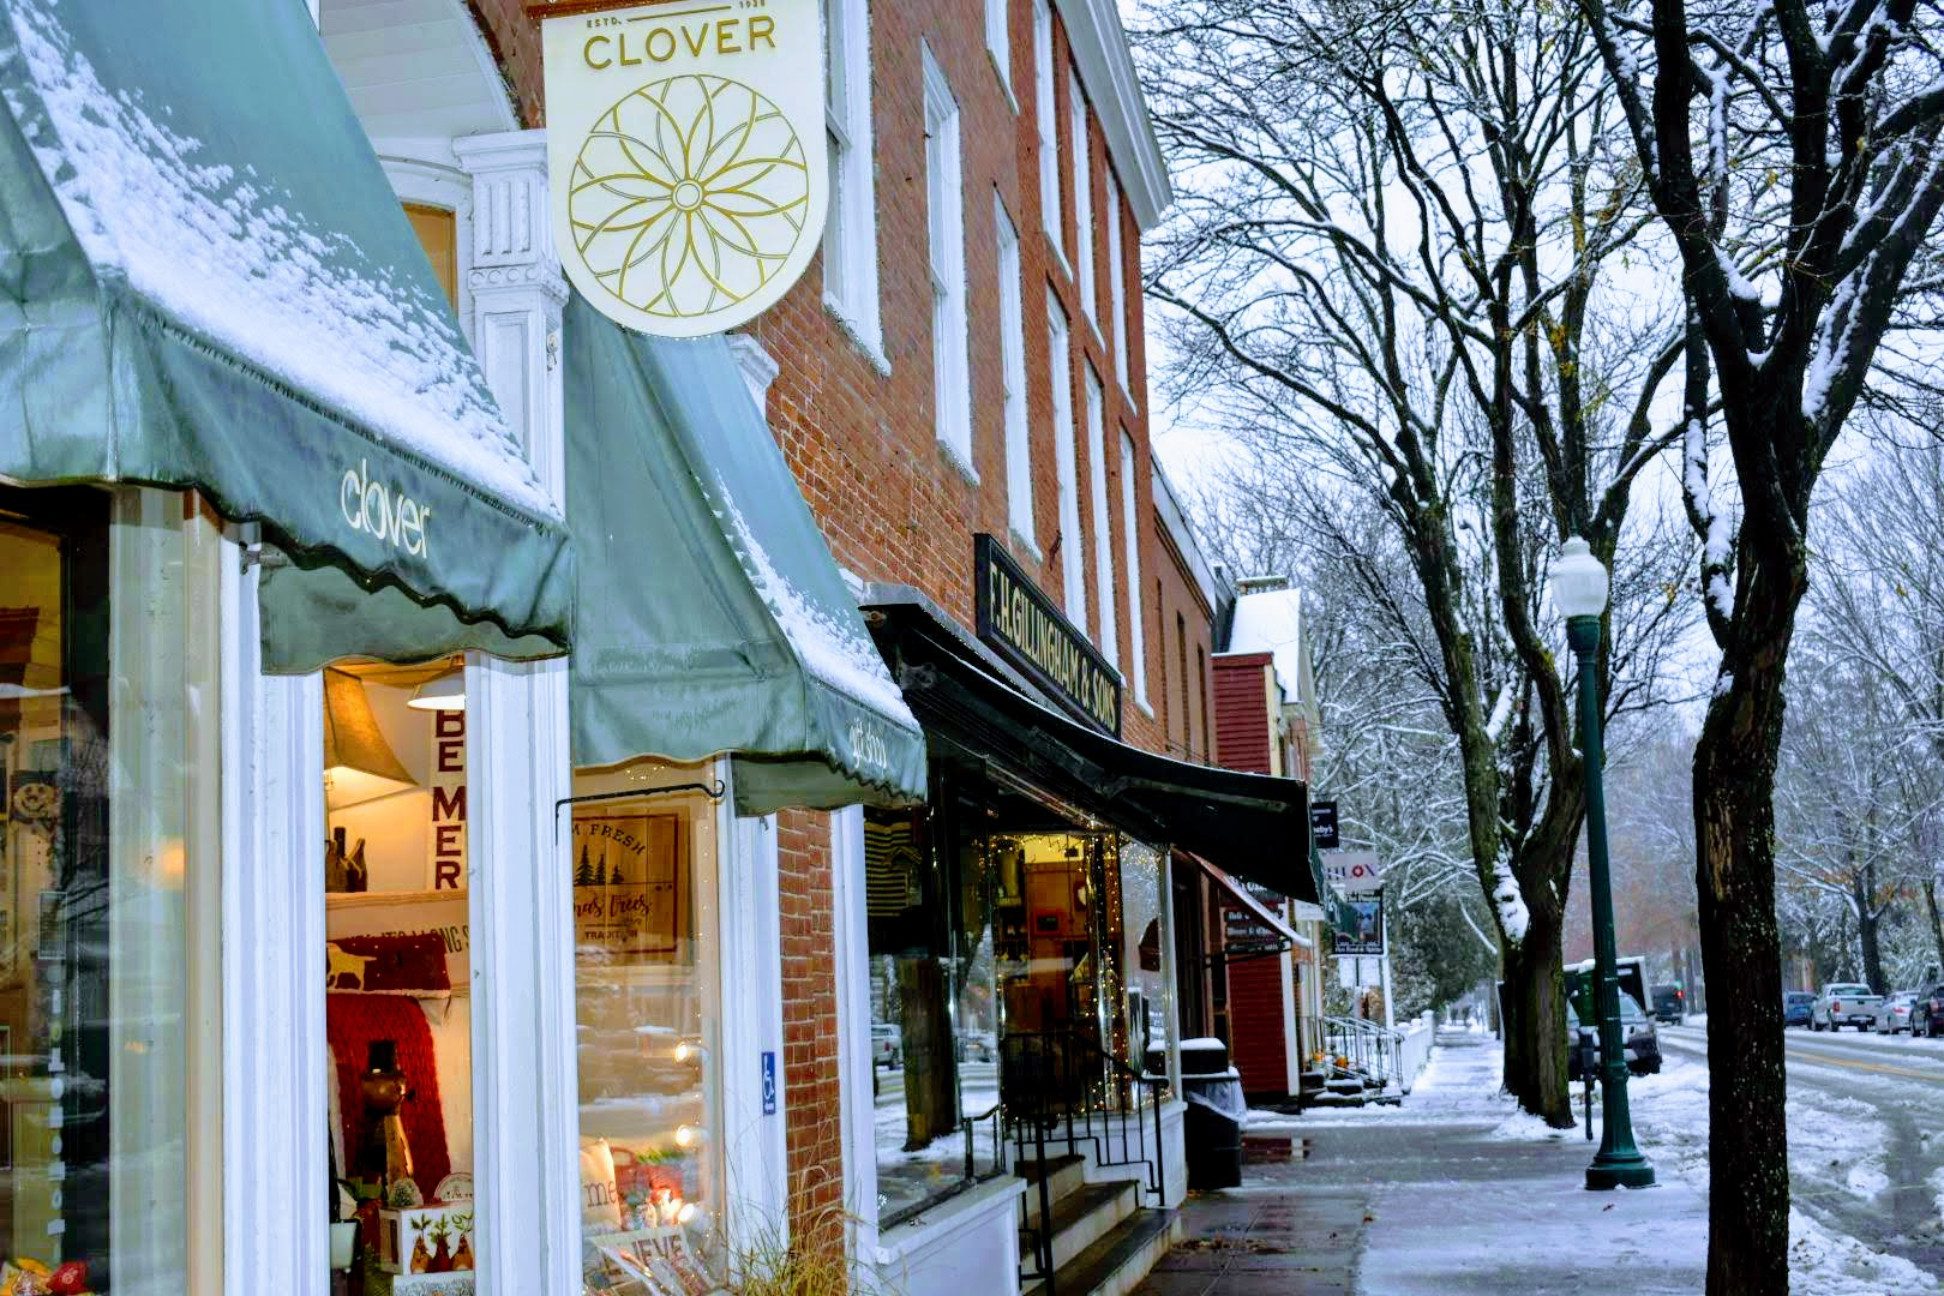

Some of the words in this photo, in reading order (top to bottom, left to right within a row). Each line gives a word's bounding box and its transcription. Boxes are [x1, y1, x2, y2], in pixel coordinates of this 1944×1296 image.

[584, 15, 776, 70] CLOVER
[587, 16, 622, 28] ESTD.
[341, 458, 430, 559] clover
[1093, 668, 1116, 733] SONS
[590, 823, 646, 856] FRESH
